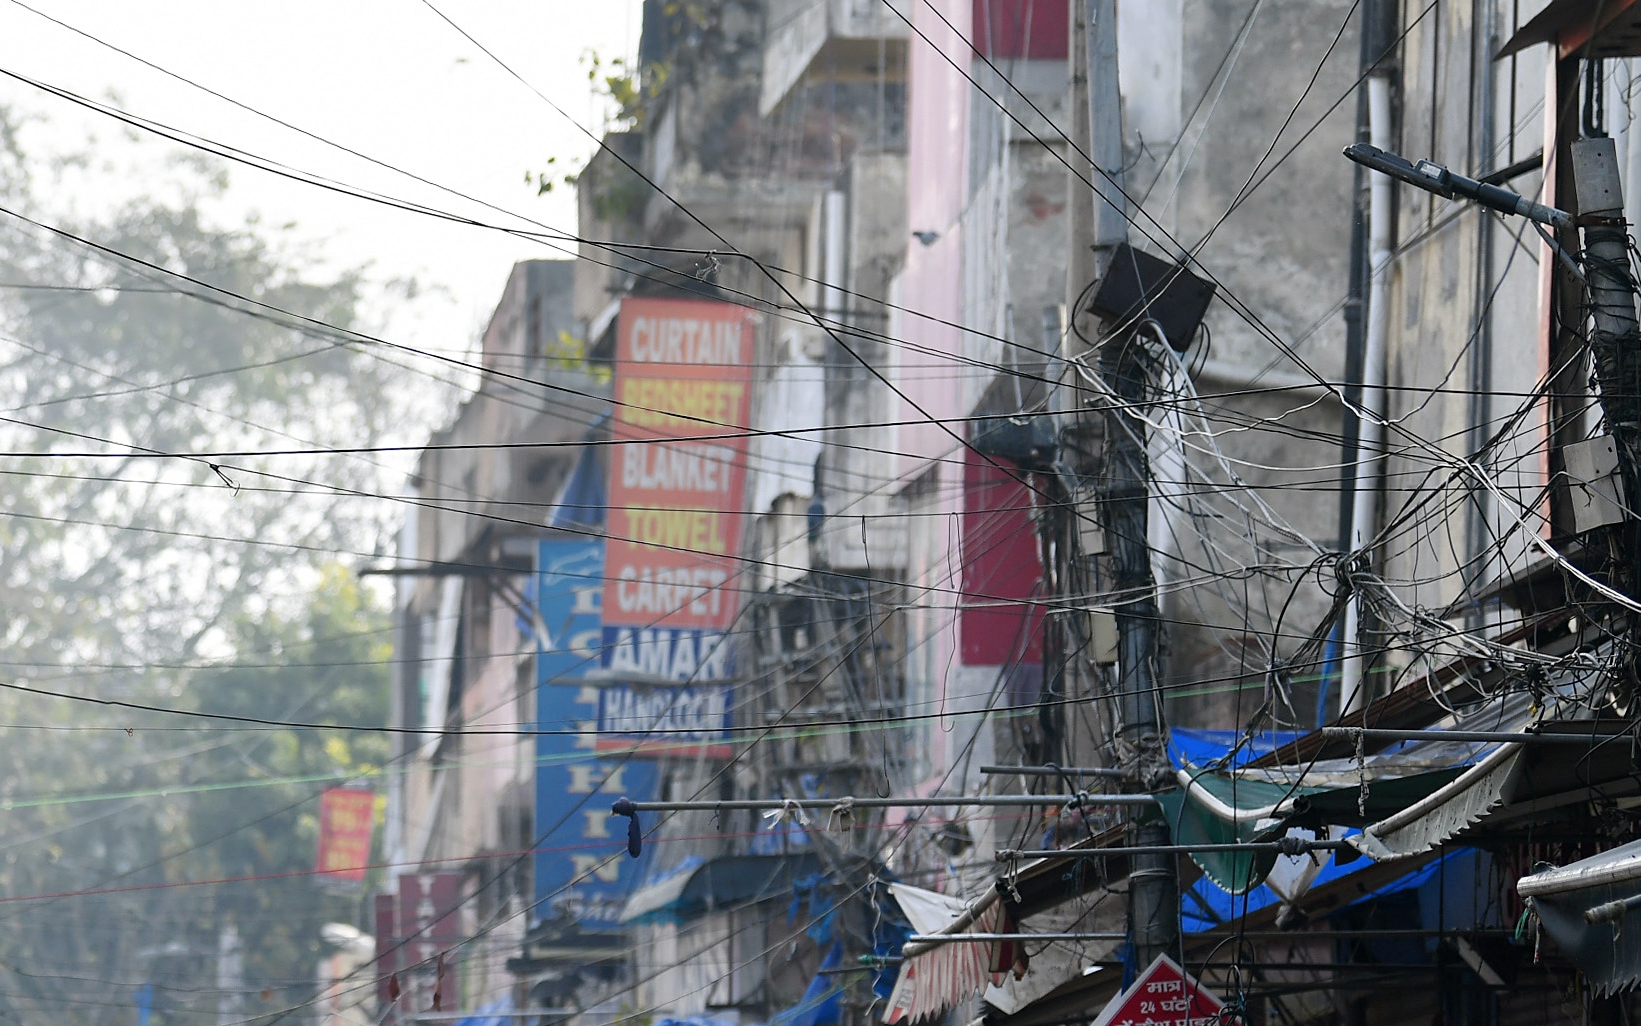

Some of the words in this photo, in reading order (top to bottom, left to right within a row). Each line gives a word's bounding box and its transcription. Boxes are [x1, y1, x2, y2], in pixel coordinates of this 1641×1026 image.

[630, 316, 742, 366] CURTAIN
[621, 376, 745, 430] BEDSHEET
[622, 443, 737, 493] BLANKET
[625, 503, 726, 553] TOWEL
[617, 564, 728, 617] CARPET
[610, 628, 729, 683] AMAR
[1140, 1001, 1156, 1014] 24
[1146, 979, 1182, 994] मात्र
